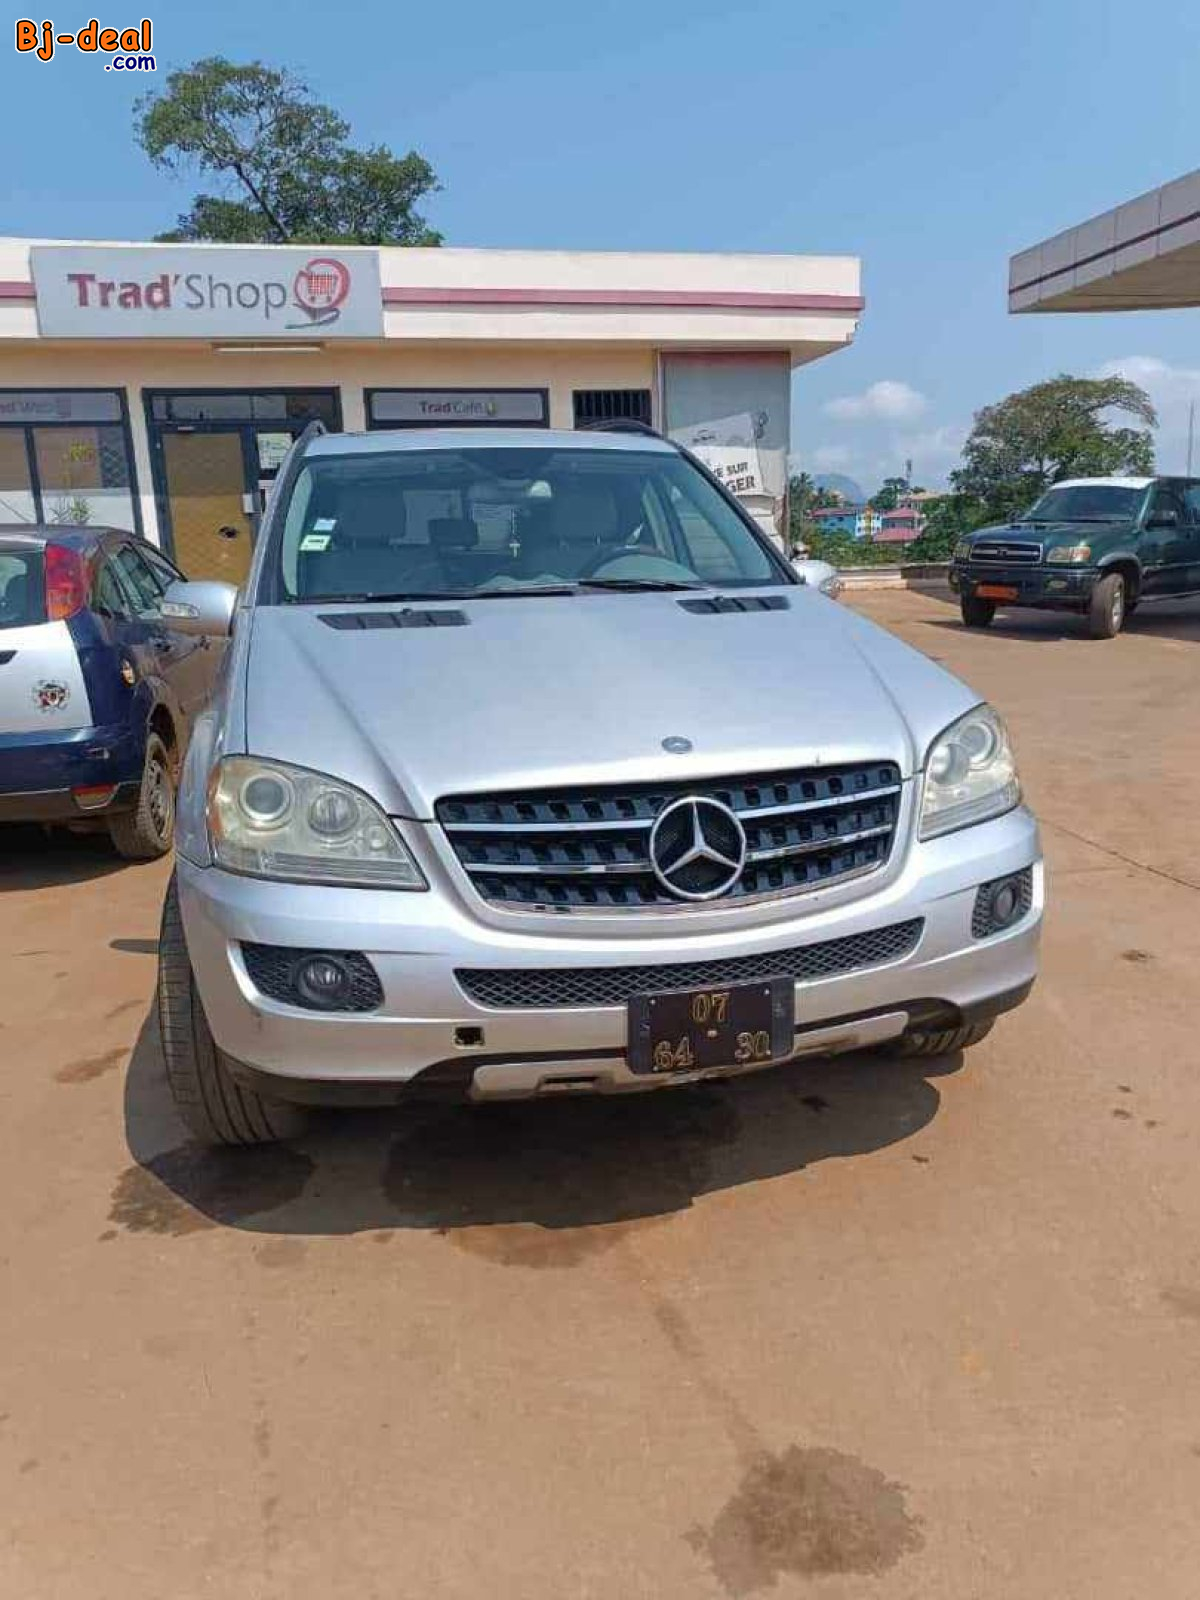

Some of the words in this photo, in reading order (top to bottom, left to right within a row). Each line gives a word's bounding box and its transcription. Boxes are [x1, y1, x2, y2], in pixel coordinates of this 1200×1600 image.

[67, 273, 287, 318] Trad'Shop
[691, 992, 730, 1022] 07
[653, 1035, 693, 1068] 64
